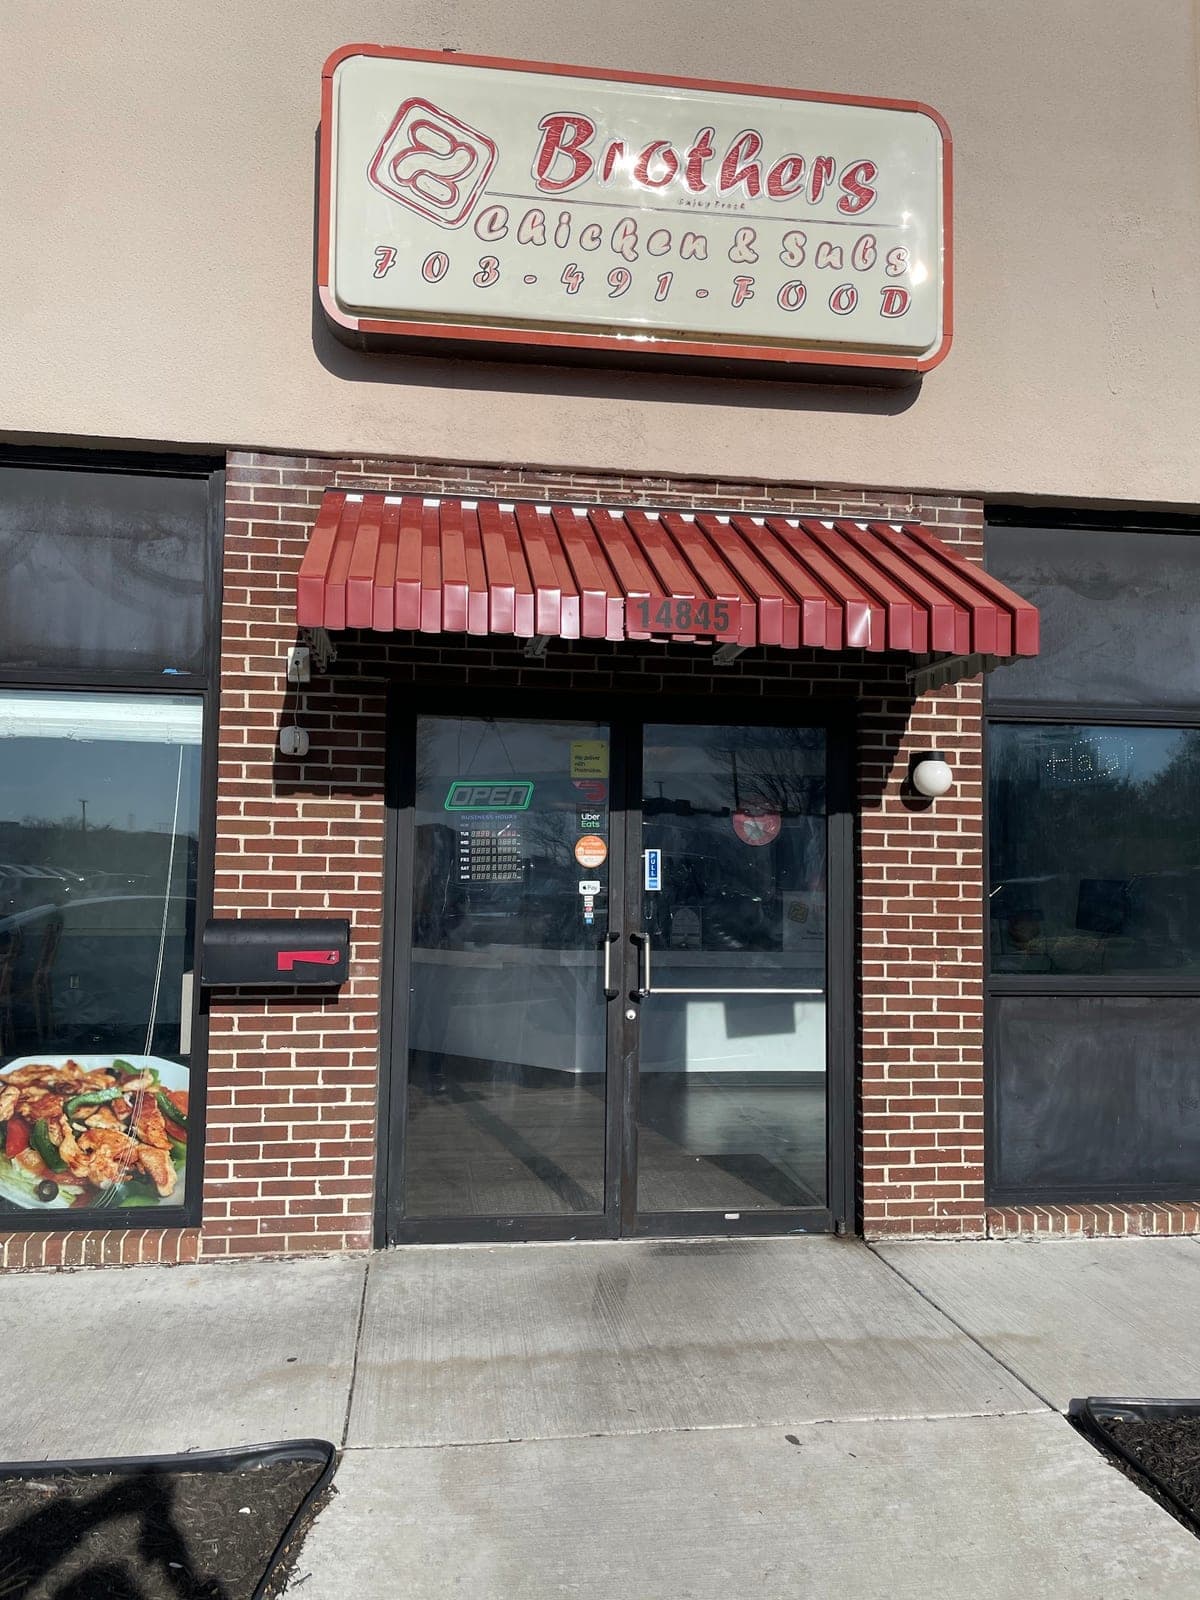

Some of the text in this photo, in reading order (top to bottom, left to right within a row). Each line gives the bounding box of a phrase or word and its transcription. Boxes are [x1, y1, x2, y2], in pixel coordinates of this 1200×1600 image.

[535, 111, 879, 214] Brothers
[473, 204, 913, 278] Chicken & Subs
[637, 599, 730, 632] 14845
[451, 786, 530, 806] OPEN
[581, 813, 600, 821] Uber
[581, 820, 600, 828] Eats
